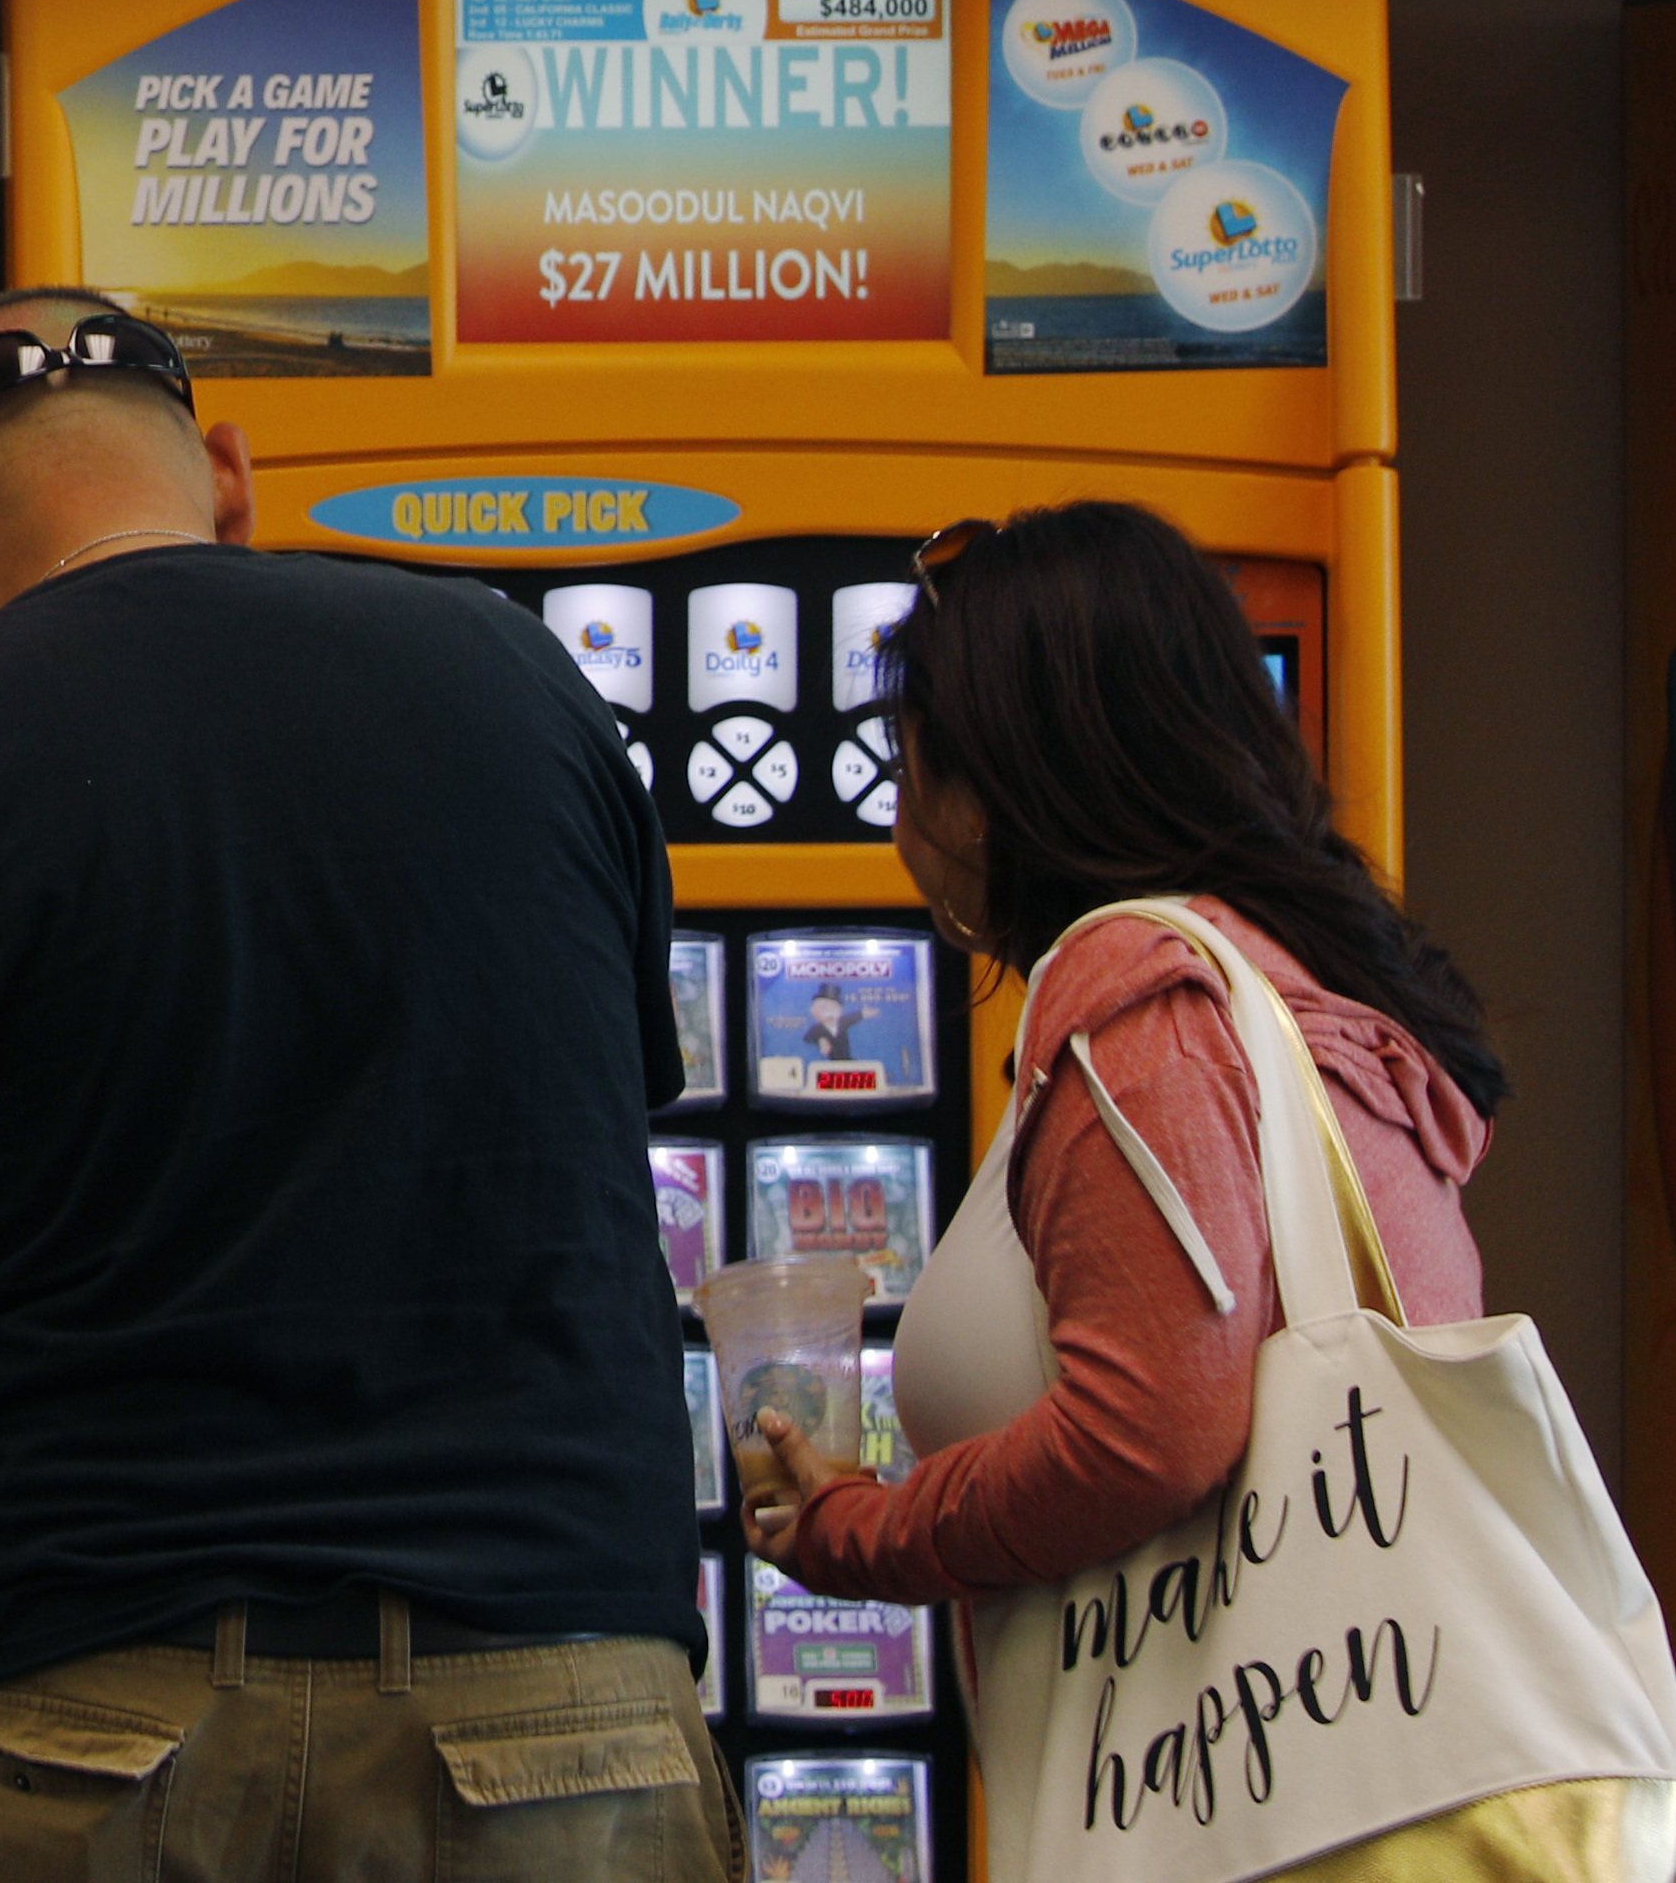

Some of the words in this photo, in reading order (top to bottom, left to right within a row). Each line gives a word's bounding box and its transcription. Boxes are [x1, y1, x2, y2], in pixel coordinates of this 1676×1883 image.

[796, 24, 857, 37] Estimated
[859, 24, 897, 37] Grand
[1051, 19, 1112, 45] MEGA
[135, 74, 224, 111] PICK
[227, 74, 255, 110] A
[263, 73, 374, 110] GAME
[543, 46, 910, 128] WINNER!
[133, 118, 267, 169] PLAY
[274, 116, 375, 167] FOR
[1127, 164, 1156, 176] WED
[1171, 157, 1194, 170] SAT
[130, 173, 379, 227] MILLIONS
[544, 188, 745, 225] MASOODUL
[753, 188, 866, 231] NAQVI
[1170, 237, 1298, 273] SuperLotto
[538, 248, 622, 308] $27
[634, 248, 869, 301] MILLION!
[1208, 290, 1240, 304] WED
[1255, 283, 1281, 298] SAT
[392, 491, 532, 540] QUICK
[543, 490, 650, 533] PICK
[625, 647, 642, 669] 5
[705, 651, 762, 677] Daily
[765, 651, 779, 669] 4
[770, 763, 787, 780] $5
[789, 961, 891, 979] MONOPOLY
[1311, 1385, 1409, 1549] it
[763, 1609, 885, 1636] POKER
[1084, 1618, 1441, 1831] happen
